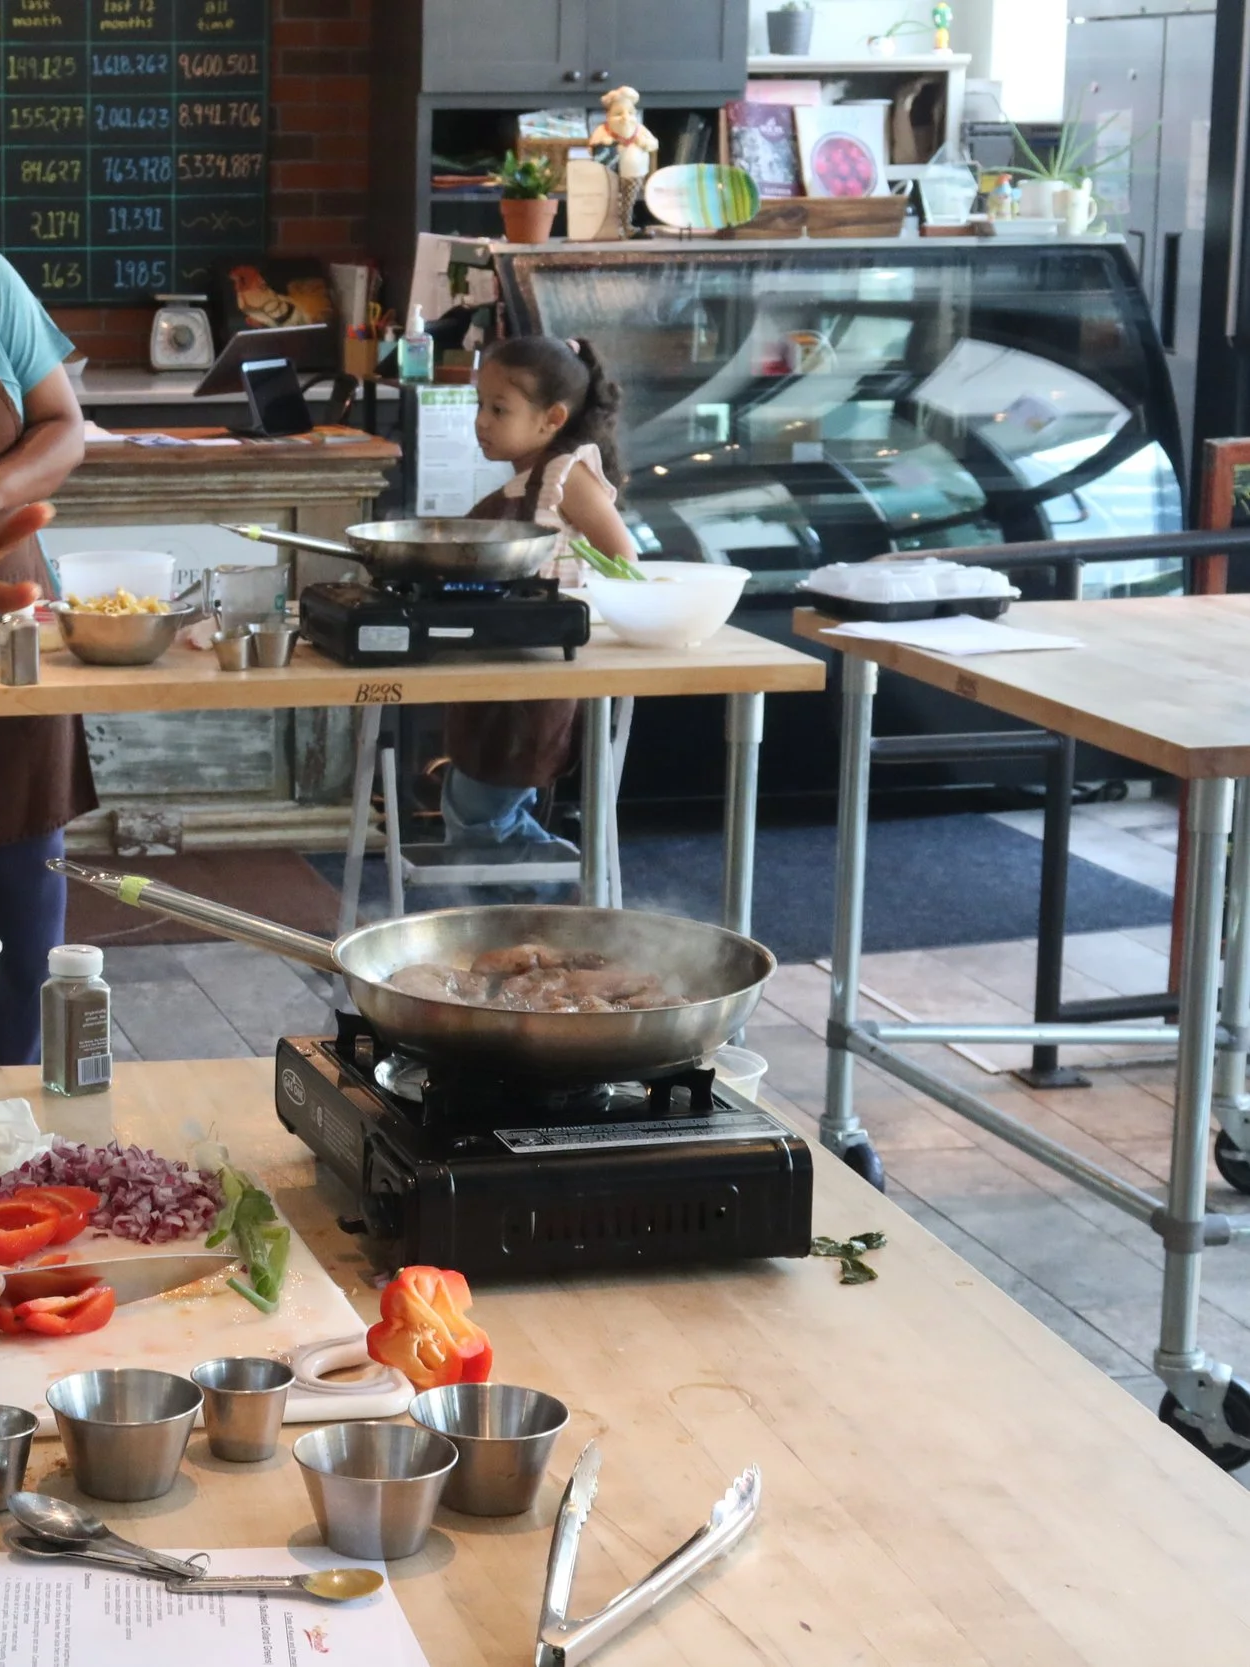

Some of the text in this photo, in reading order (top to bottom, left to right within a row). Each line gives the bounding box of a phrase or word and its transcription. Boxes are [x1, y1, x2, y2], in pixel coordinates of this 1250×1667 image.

[12, 14, 62, 28] month
[100, 16, 154, 31] months
[196, 17, 235, 31] time
[41, 261, 83, 289] 163
